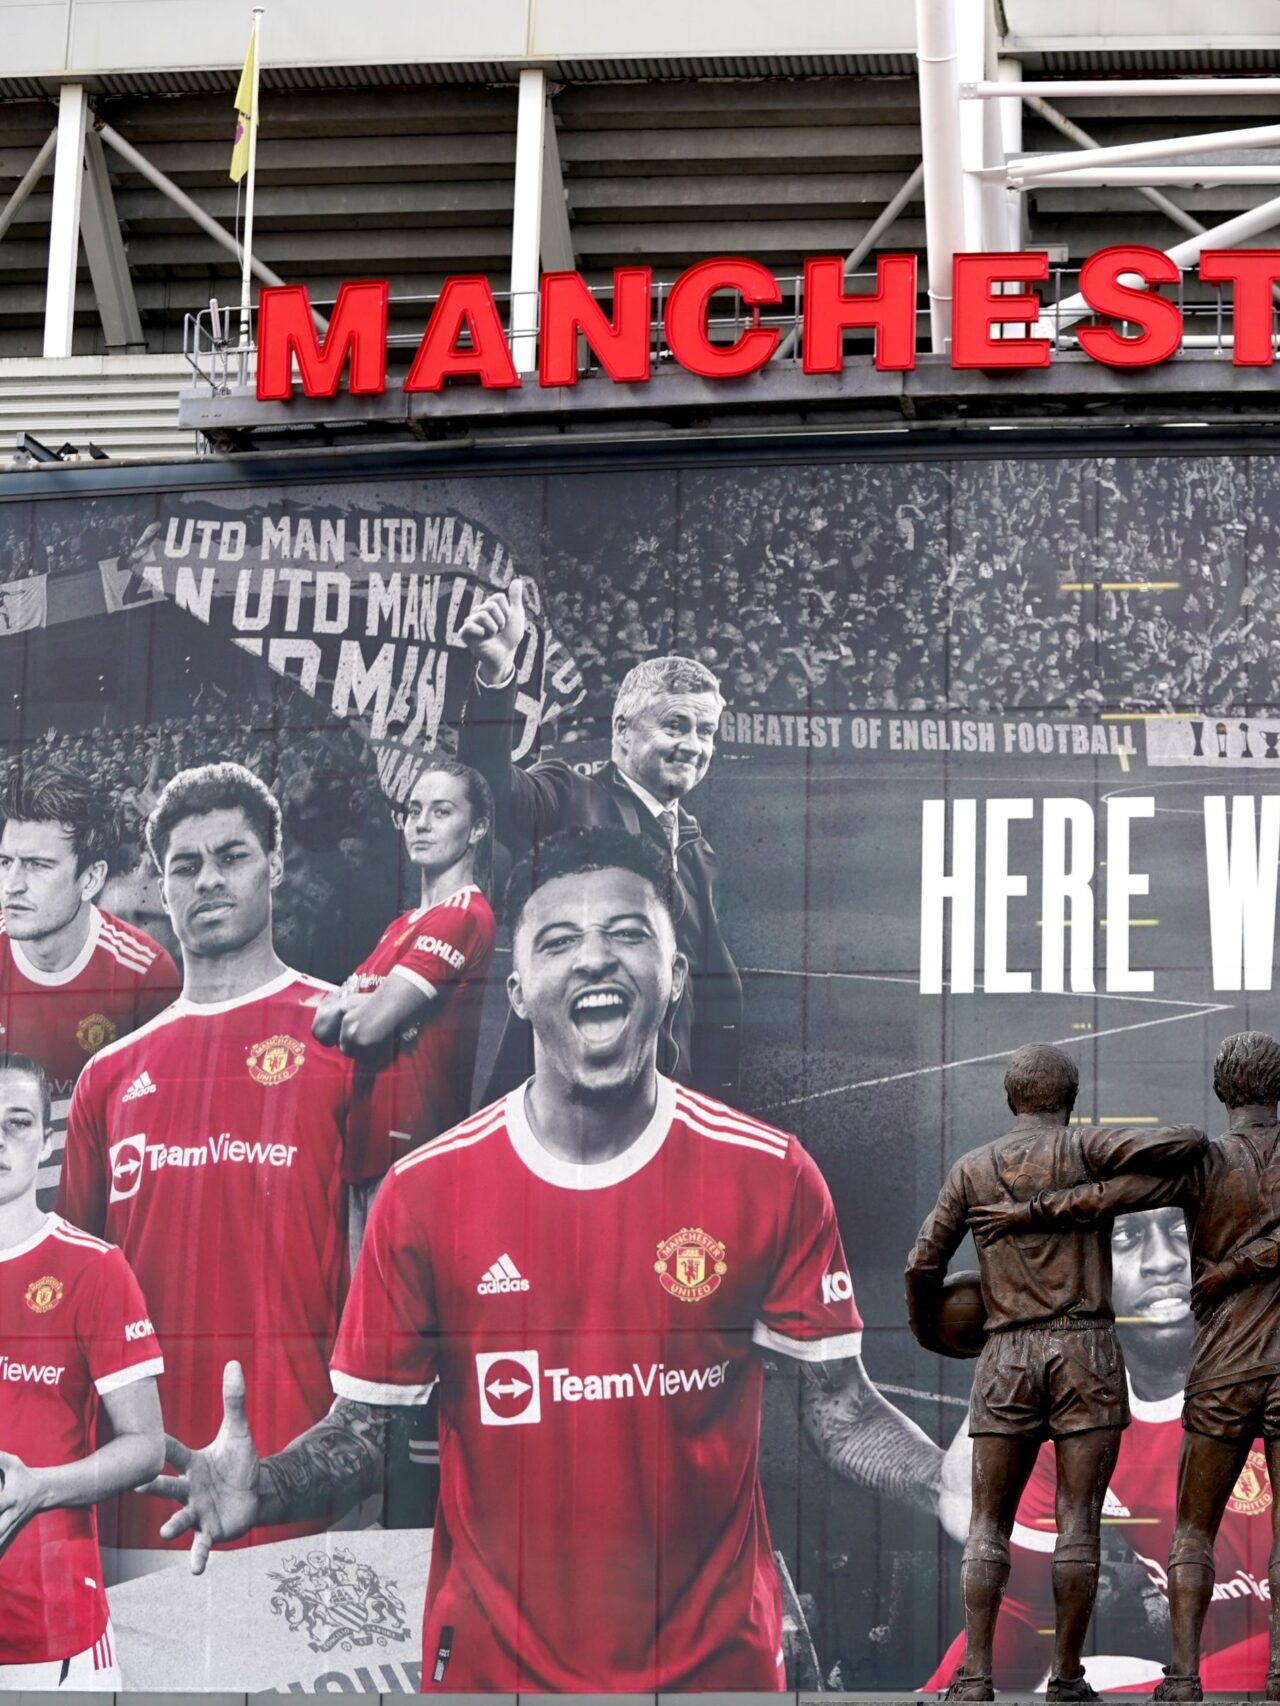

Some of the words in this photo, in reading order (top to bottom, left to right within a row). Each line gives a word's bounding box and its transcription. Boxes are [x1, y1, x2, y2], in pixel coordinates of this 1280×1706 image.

[164, 517, 246, 561] UTD
[261, 516, 345, 562] MAN
[359, 518, 416, 563] UTD
[422, 516, 484, 571] MAN
[232, 568, 350, 634] UTD
[365, 571, 441, 642] MAN
[332, 639, 449, 753] MAN
[720, 711, 842, 748] GREATEST
[851, 717, 882, 749] OF
[889, 719, 996, 752] ENGLISH
[1003, 722, 1137, 755] FOOTBALL
[920, 797, 1155, 994] HERE
[414, 935, 466, 969] KOHLER
[145, 1132, 298, 1171] TeamViewer
[661, 1232, 721, 1257] MANCHESTER
[477, 1276, 531, 1295] adidas
[670, 1283, 711, 1298] UNITED
[544, 1360, 730, 1402] TeamViewer
[1234, 1493, 1271, 1511] UNITED
